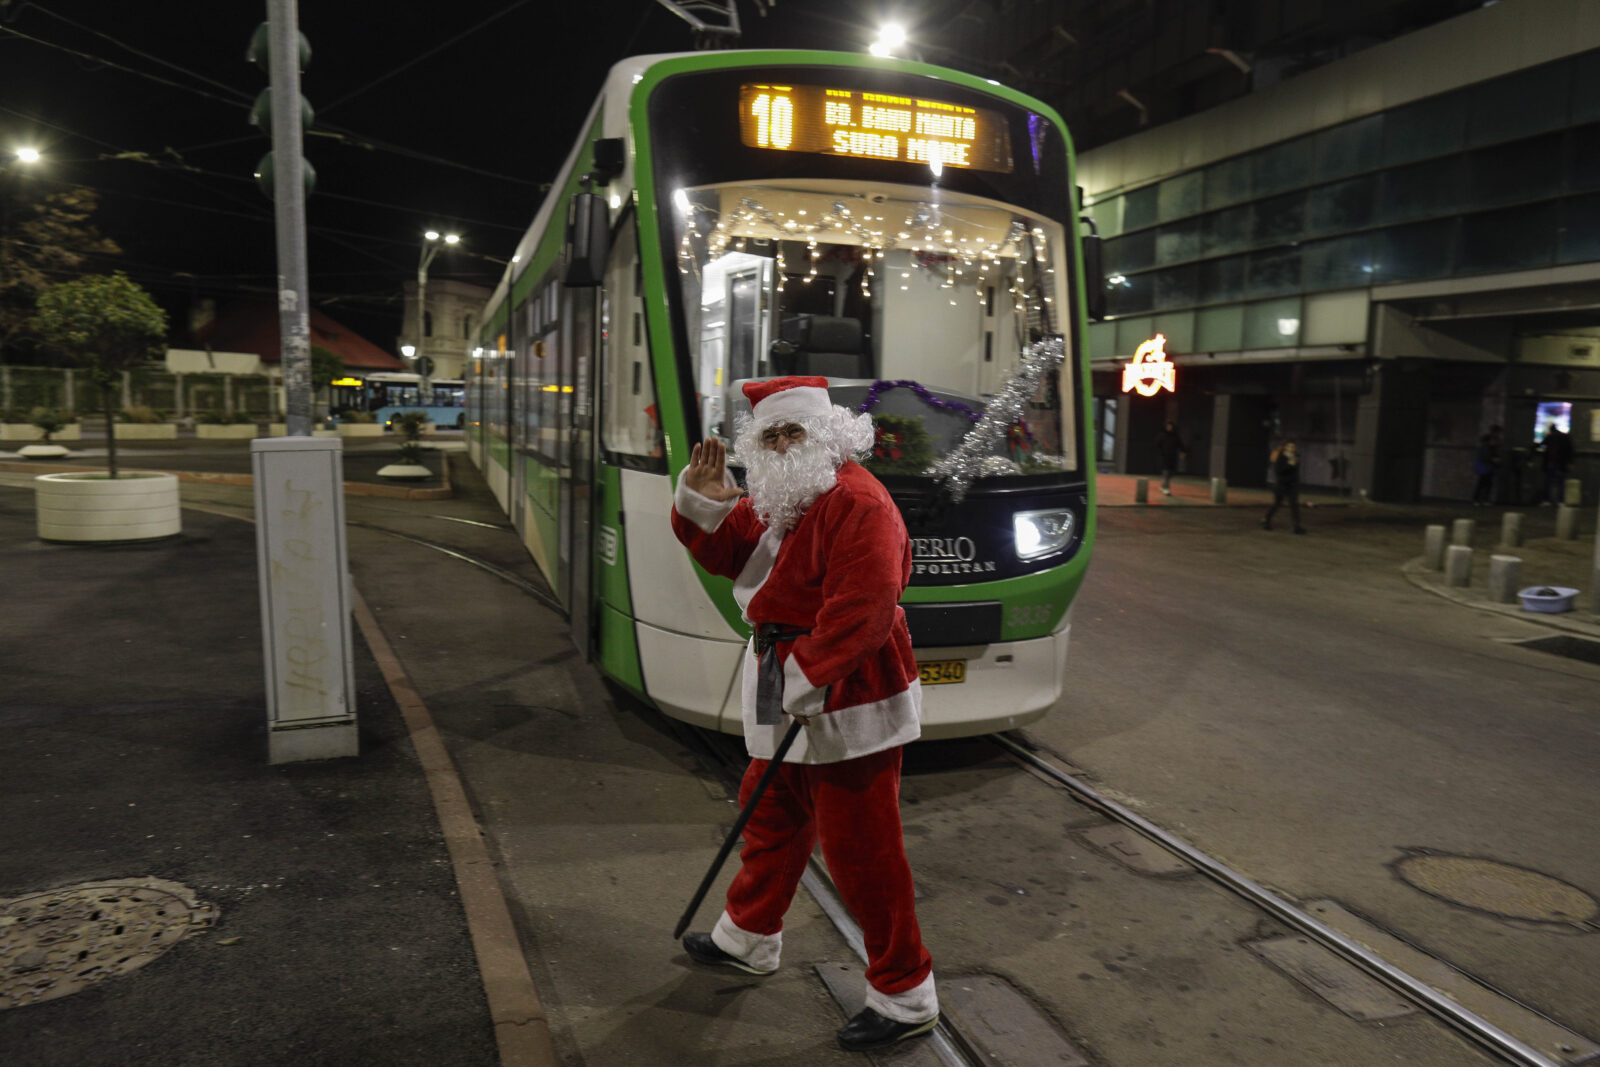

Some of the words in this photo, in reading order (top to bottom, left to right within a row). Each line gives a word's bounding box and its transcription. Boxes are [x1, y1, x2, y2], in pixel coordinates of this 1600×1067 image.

[752, 94, 793, 149] 10
[911, 561, 997, 574] POLITAN
[918, 660, 964, 682] 5340
